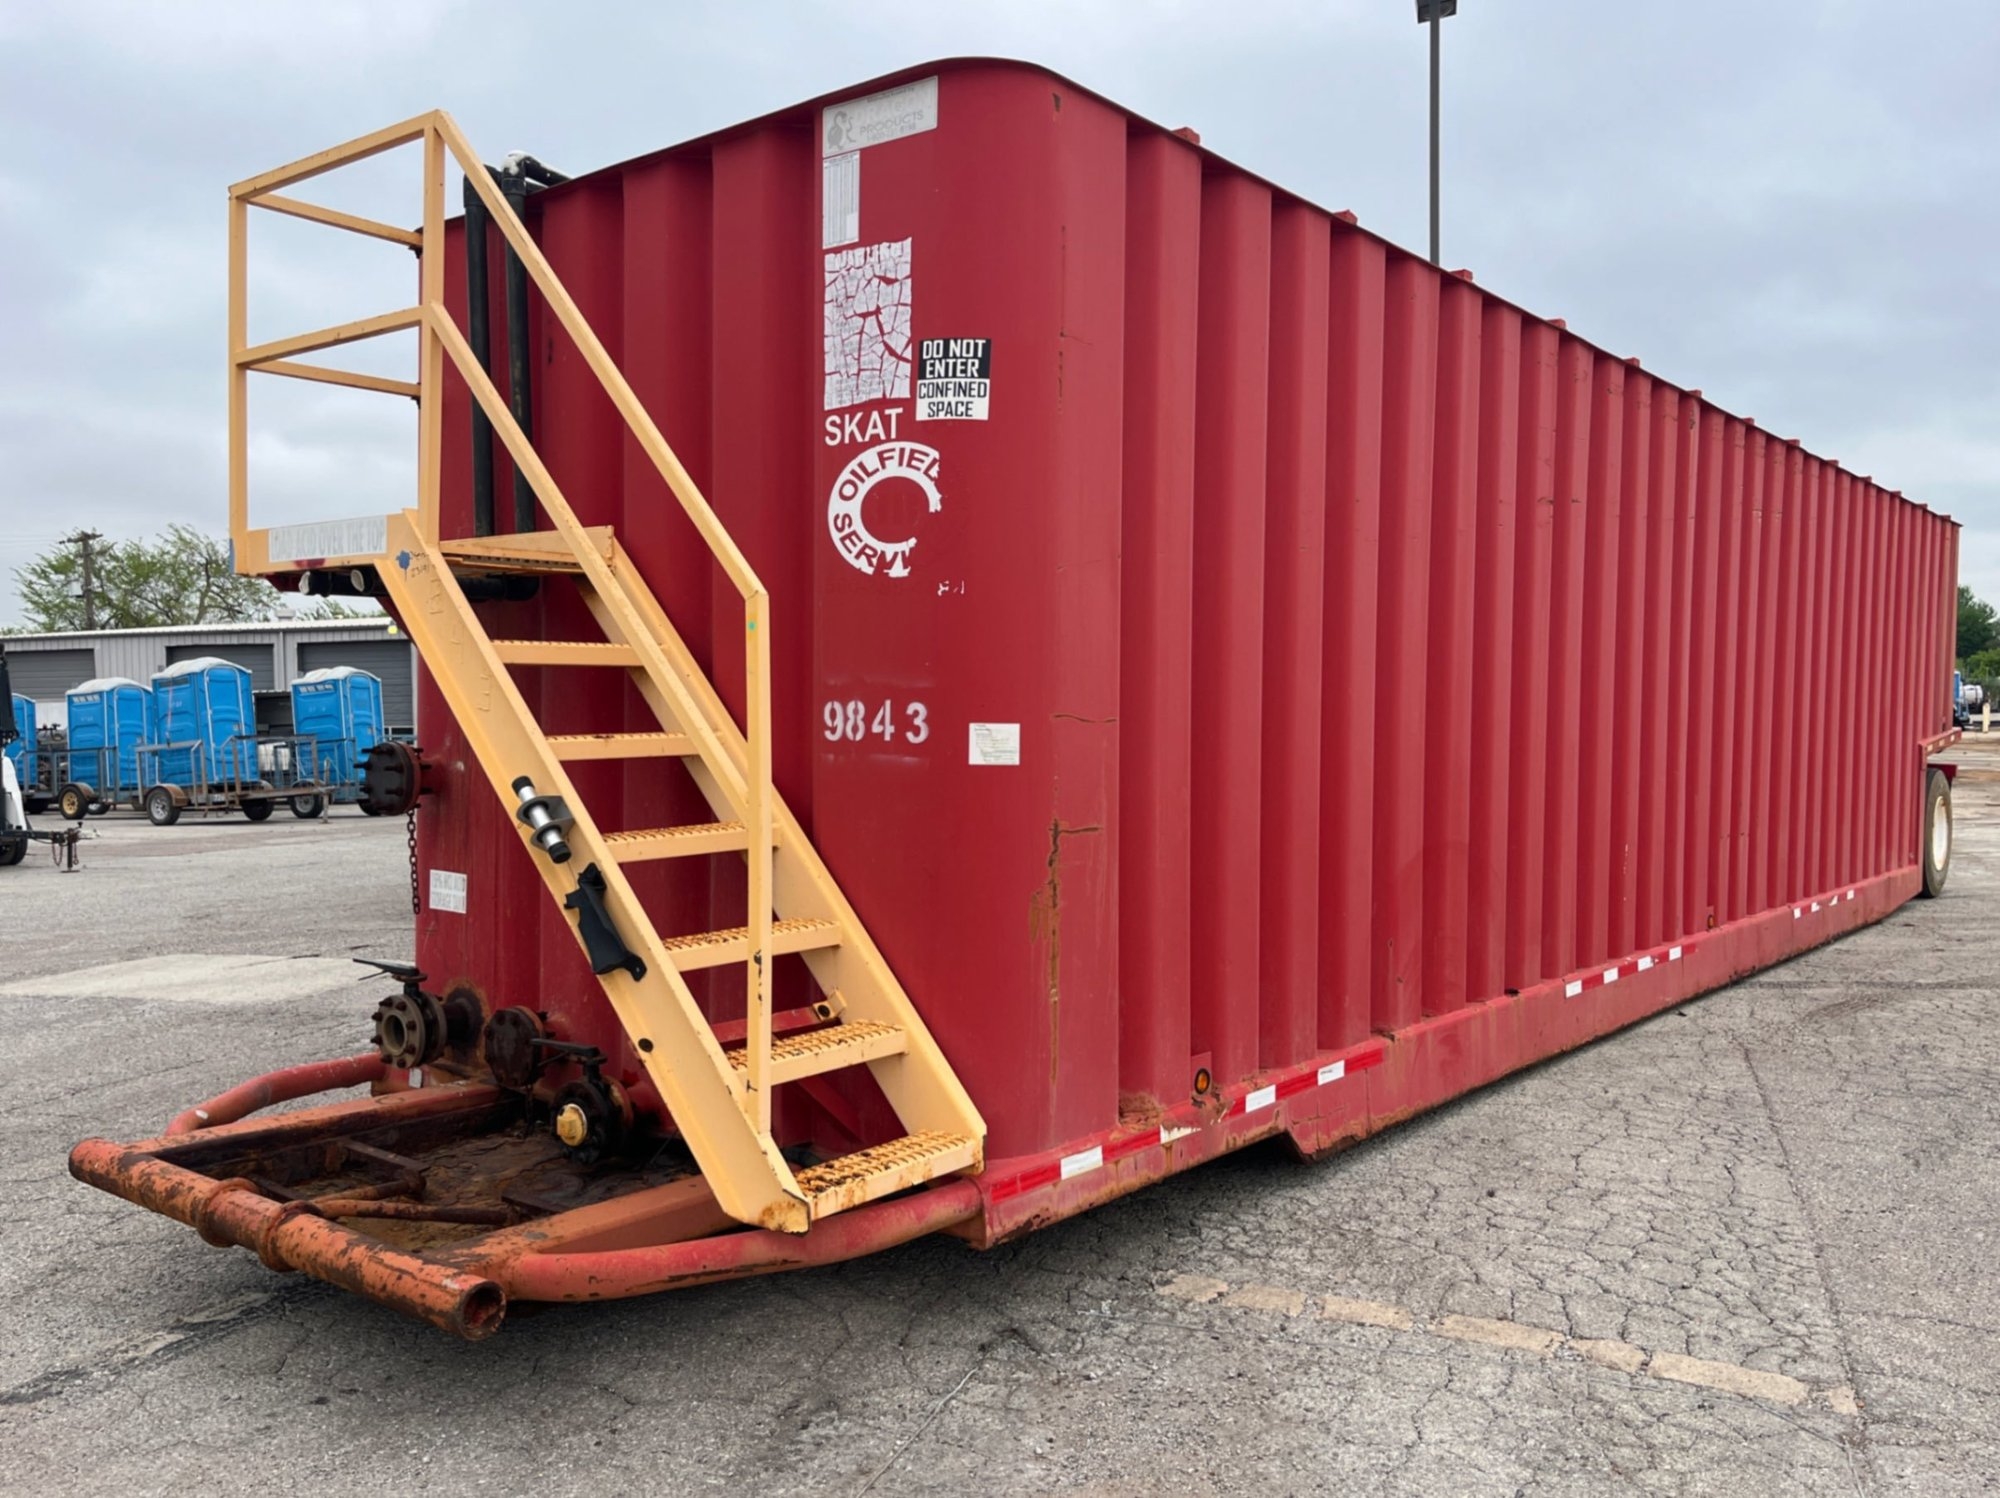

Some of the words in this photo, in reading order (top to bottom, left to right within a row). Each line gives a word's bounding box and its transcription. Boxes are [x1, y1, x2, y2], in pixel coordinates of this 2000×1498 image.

[859, 110, 924, 135] PRODUCTS
[923, 339, 944, 359] DO
[949, 338, 986, 358] NOT
[926, 358, 979, 378] ENTER
[918, 381, 988, 399] CONFINED
[927, 401, 974, 418] SPACE
[824, 408, 903, 446] SKAT
[321, 521, 348, 556] OVER
[350, 519, 366, 553] THE
[824, 699, 929, 744] 9843
